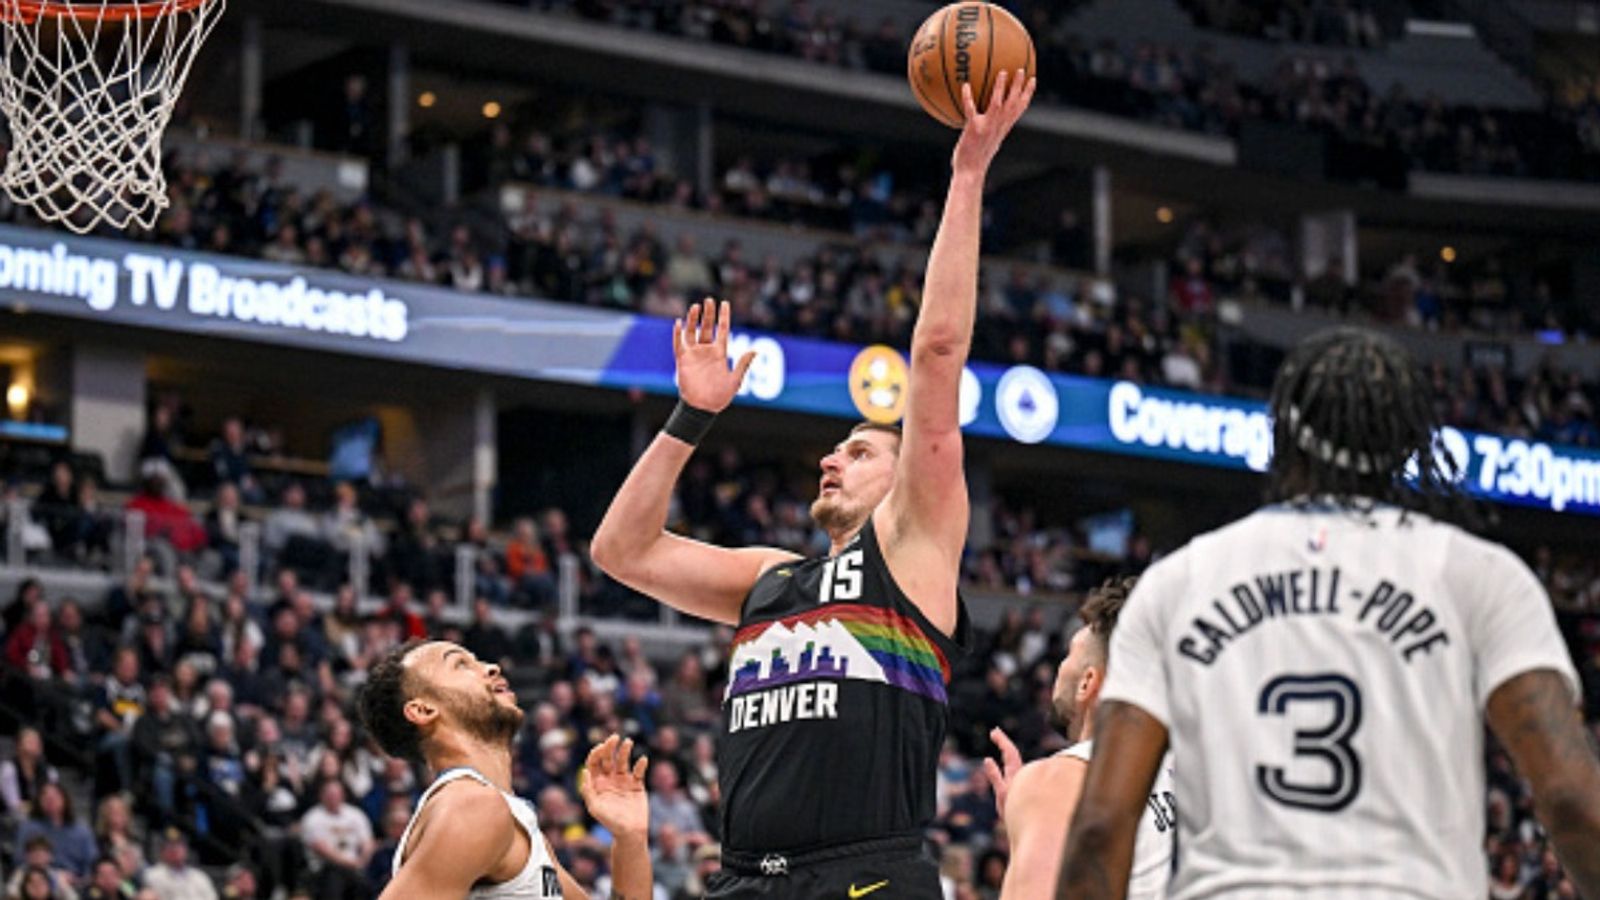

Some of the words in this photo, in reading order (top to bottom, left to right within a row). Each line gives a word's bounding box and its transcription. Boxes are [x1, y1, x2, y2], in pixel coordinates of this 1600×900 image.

[955, 5, 979, 83] Wilson
[124, 253, 183, 309] TV
[188, 263, 408, 342] Broadcasts
[1109, 381, 1274, 472] Coverag
[1474, 435, 1600, 511] 7:30pm
[819, 549, 865, 603] 15
[1178, 567, 1449, 667] CALDWELL-POPE
[729, 682, 839, 733] DENVER
[1256, 672, 1363, 814] 3
